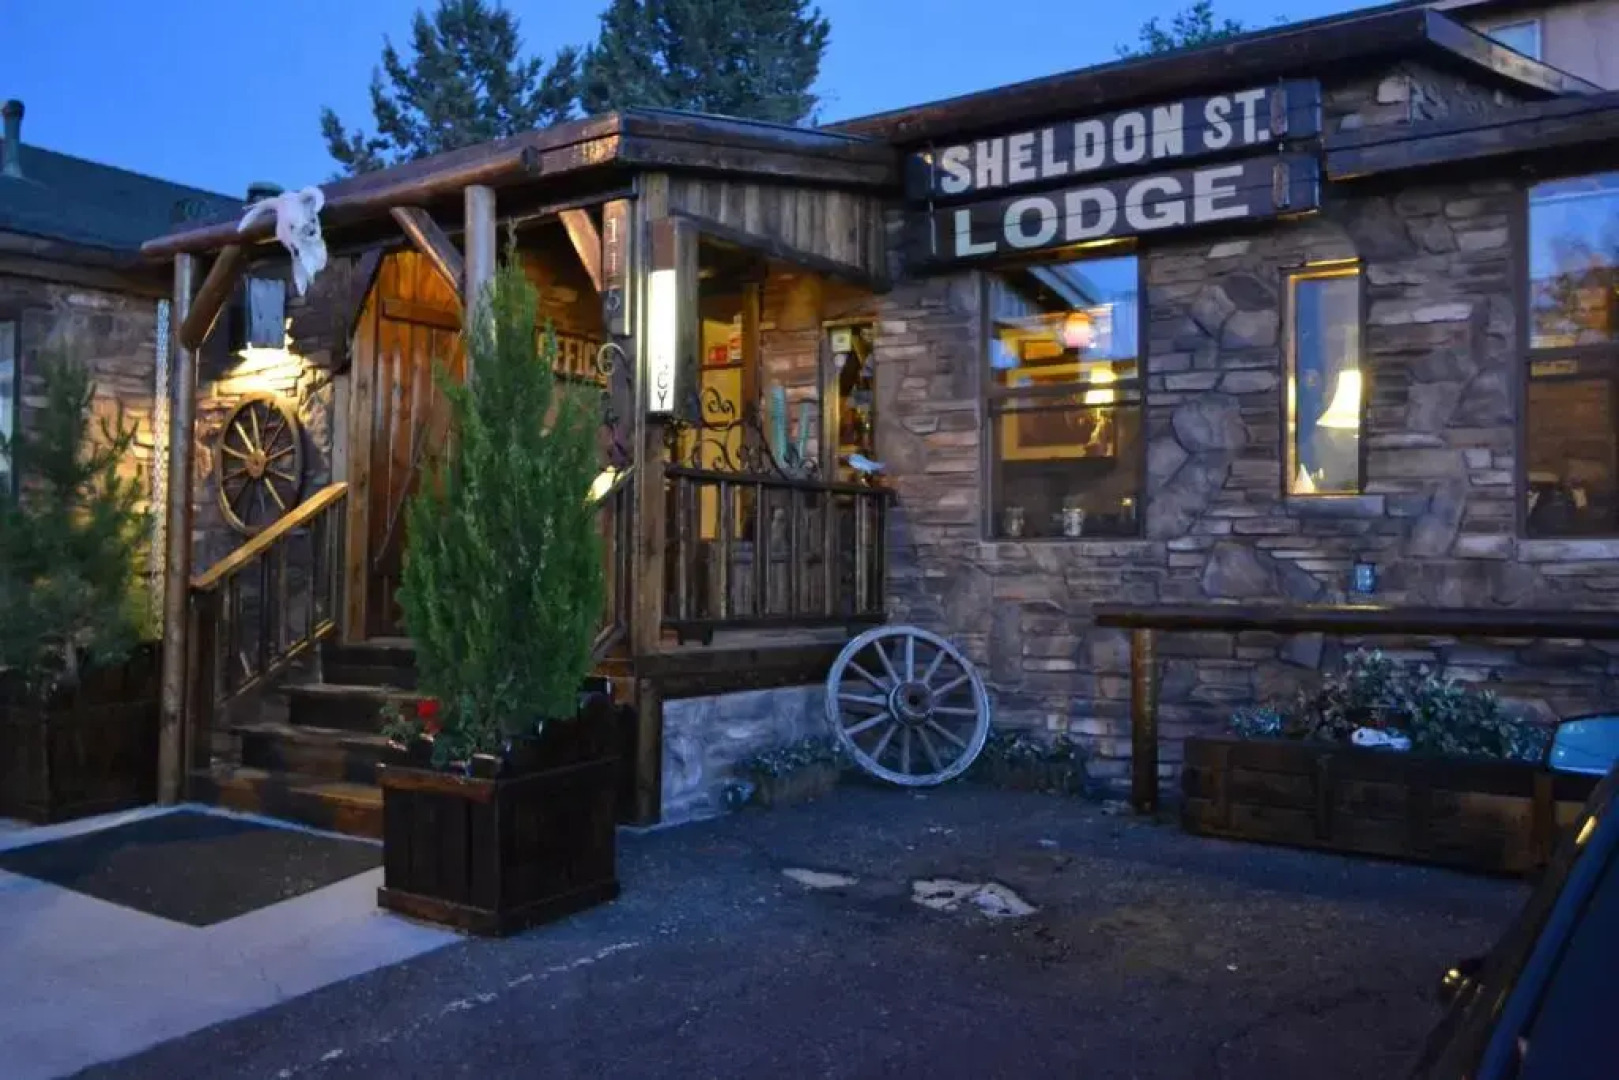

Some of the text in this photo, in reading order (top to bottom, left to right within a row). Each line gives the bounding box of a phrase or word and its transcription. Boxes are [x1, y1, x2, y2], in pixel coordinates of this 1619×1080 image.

[941, 88, 1270, 194] SHELDON ST.
[955, 165, 1249, 257] LODGE
[537, 332, 602, 380] FFIC
